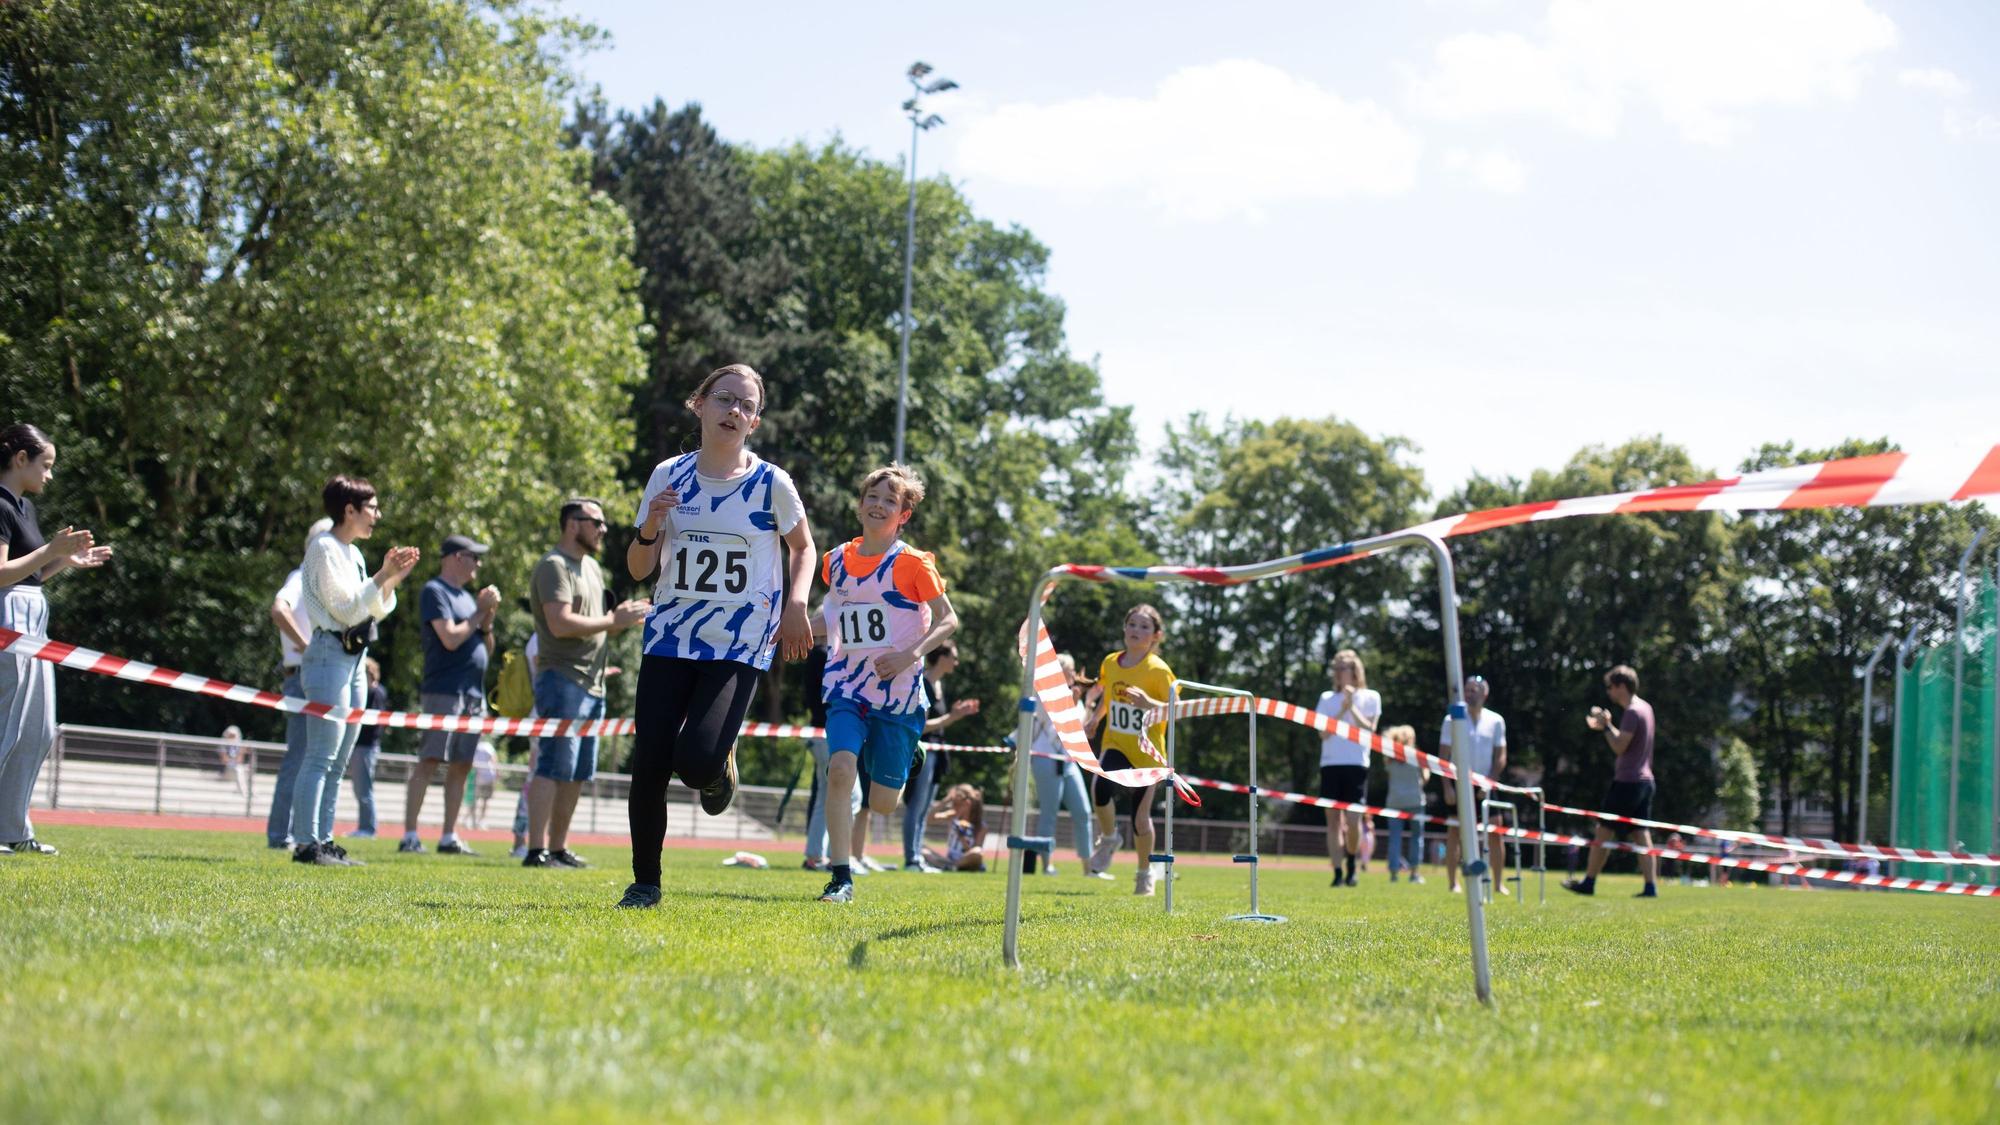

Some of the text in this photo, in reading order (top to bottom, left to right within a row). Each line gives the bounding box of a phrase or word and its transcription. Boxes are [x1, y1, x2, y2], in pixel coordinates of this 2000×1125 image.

[675, 547, 748, 594] 125
[839, 608, 886, 643] 118
[1111, 705, 1144, 731] 103
